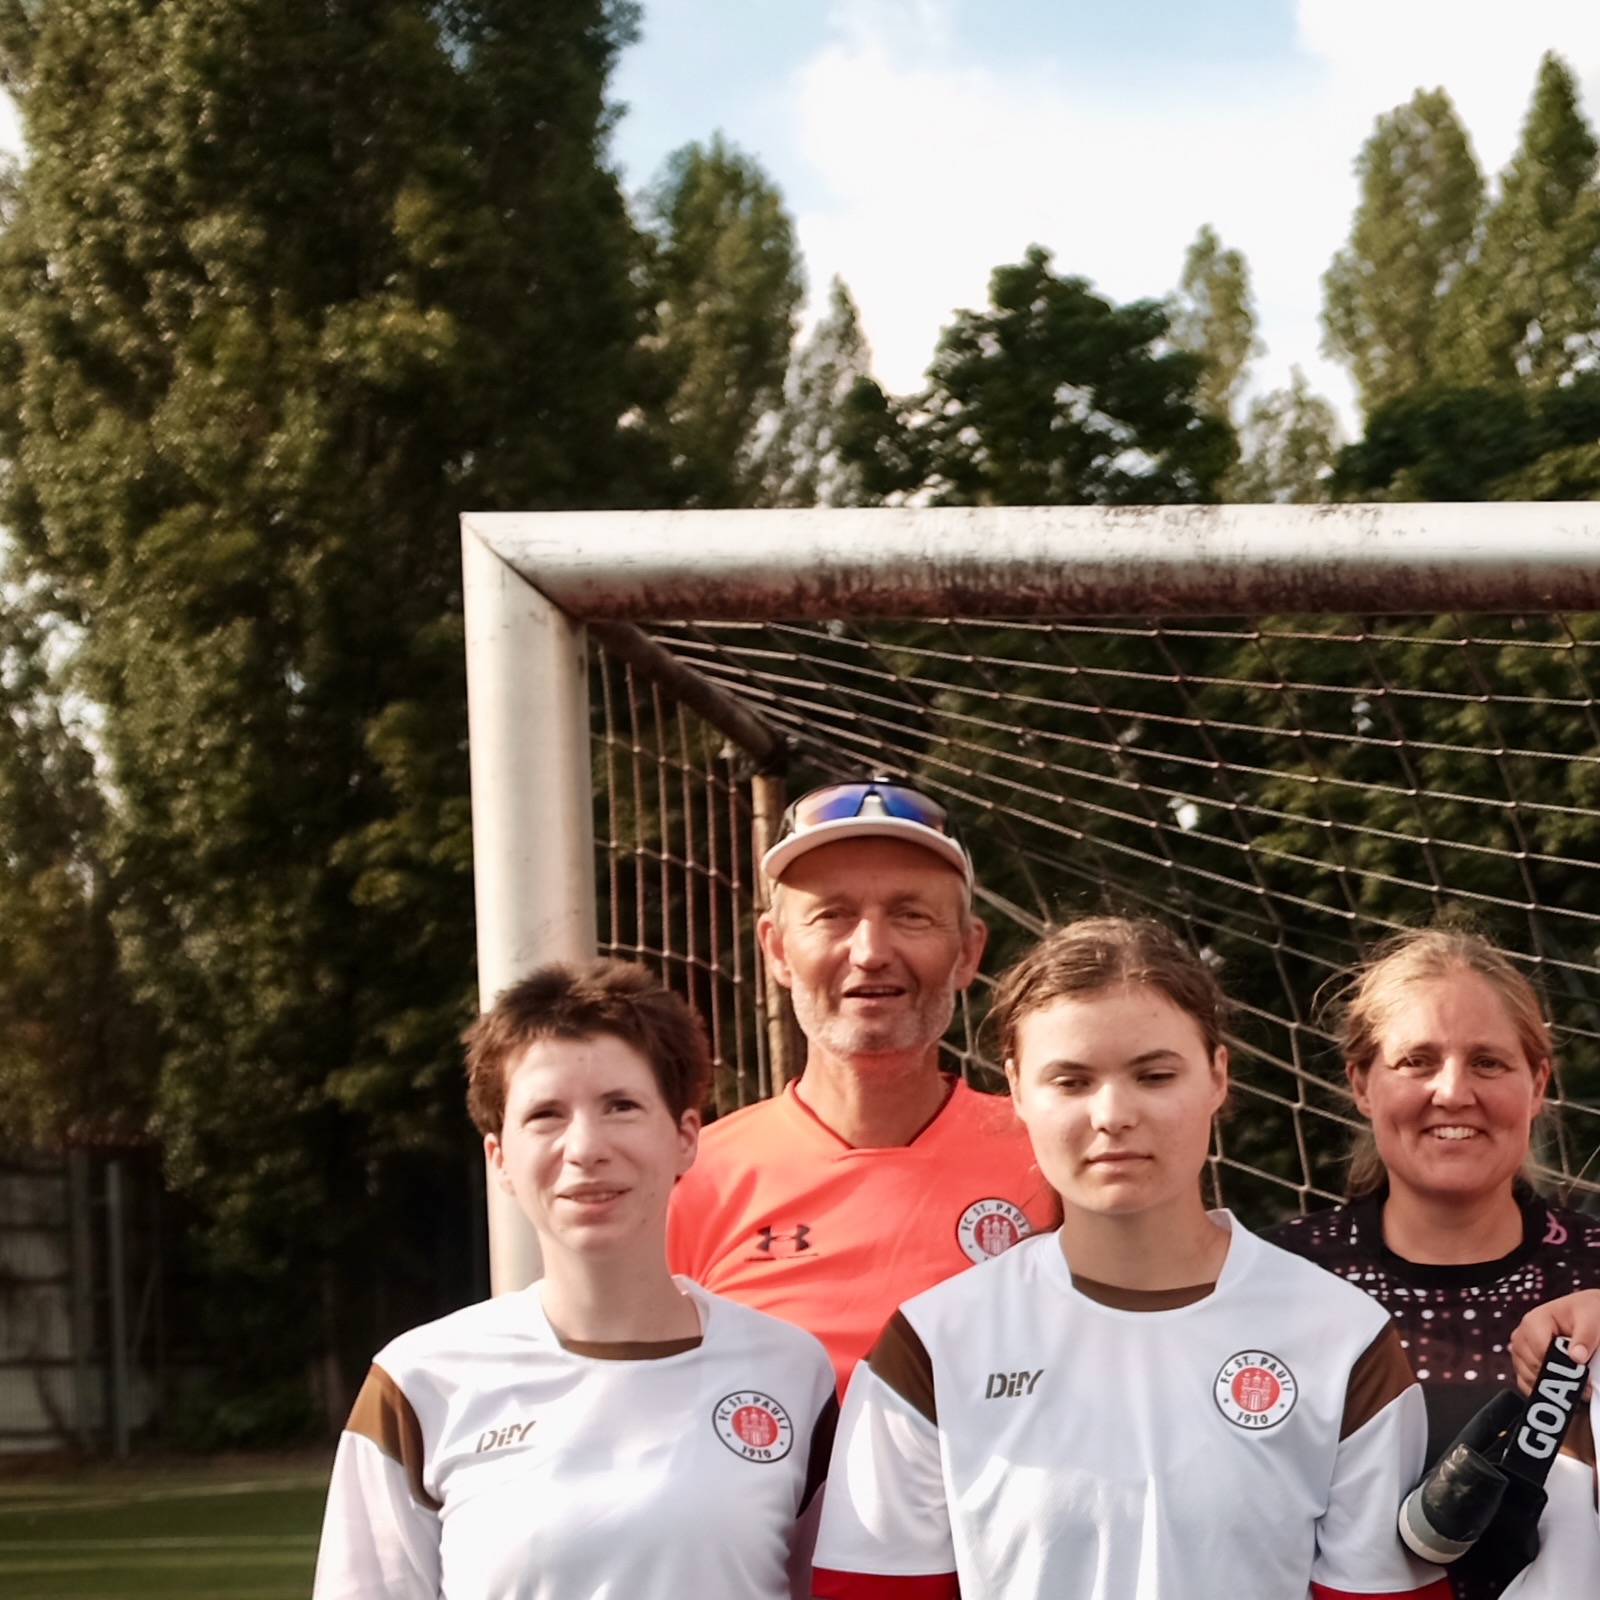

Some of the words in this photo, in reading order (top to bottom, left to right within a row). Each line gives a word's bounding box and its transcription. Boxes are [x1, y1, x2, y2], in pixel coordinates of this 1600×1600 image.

[961, 1217, 974, 1231] FC
[1220, 1370, 1234, 1384] FC
[1235, 1355, 1255, 1368] ST.
[1260, 1356, 1293, 1392] PAULI
[718, 1408, 731, 1421] FC
[753, 1396, 789, 1430] PAULI
[1236, 1411, 1269, 1425] 1910
[742, 1446, 771, 1459] 1910
